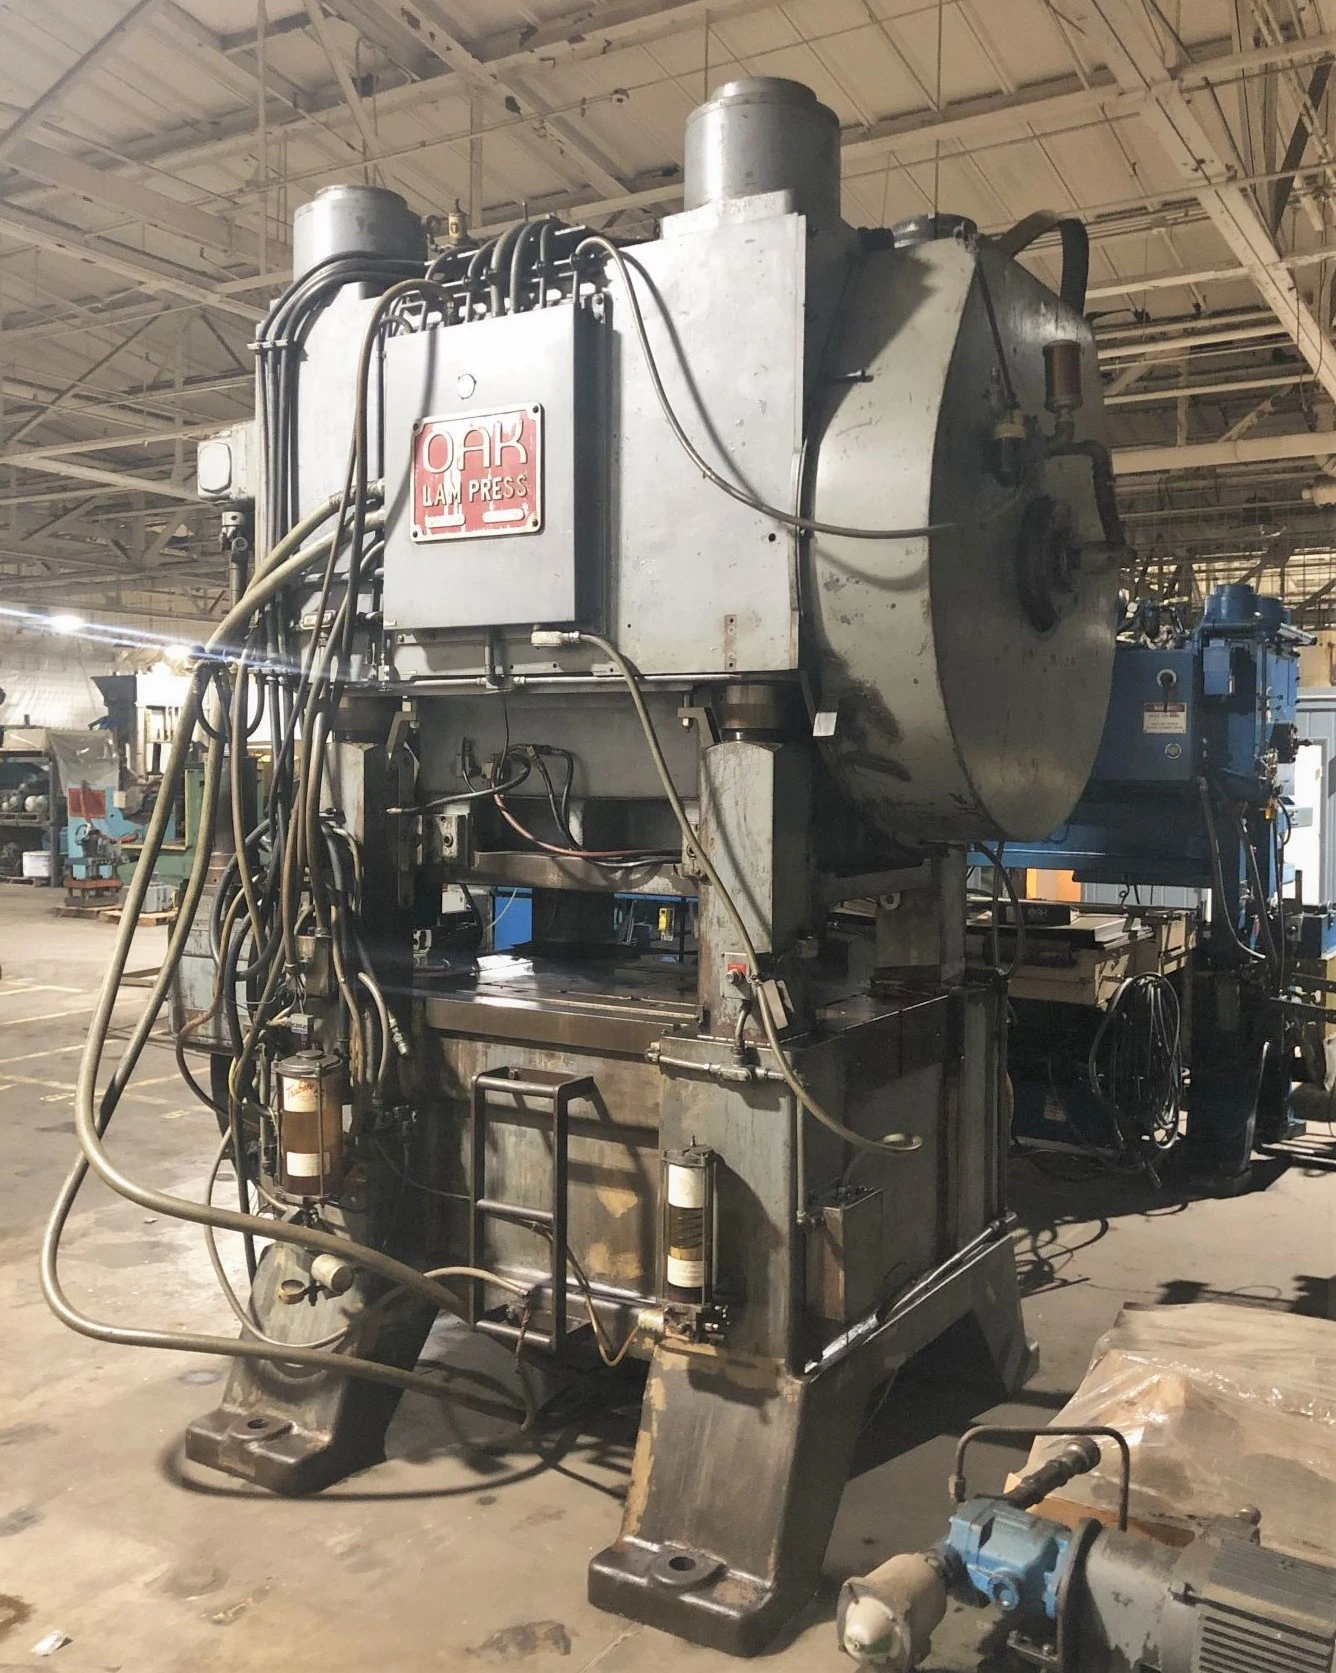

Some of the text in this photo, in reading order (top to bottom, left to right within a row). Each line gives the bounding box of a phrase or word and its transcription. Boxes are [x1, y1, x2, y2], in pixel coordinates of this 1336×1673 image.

[423, 417, 528, 473] OAK
[423, 475, 528, 507] LAM PRESS
